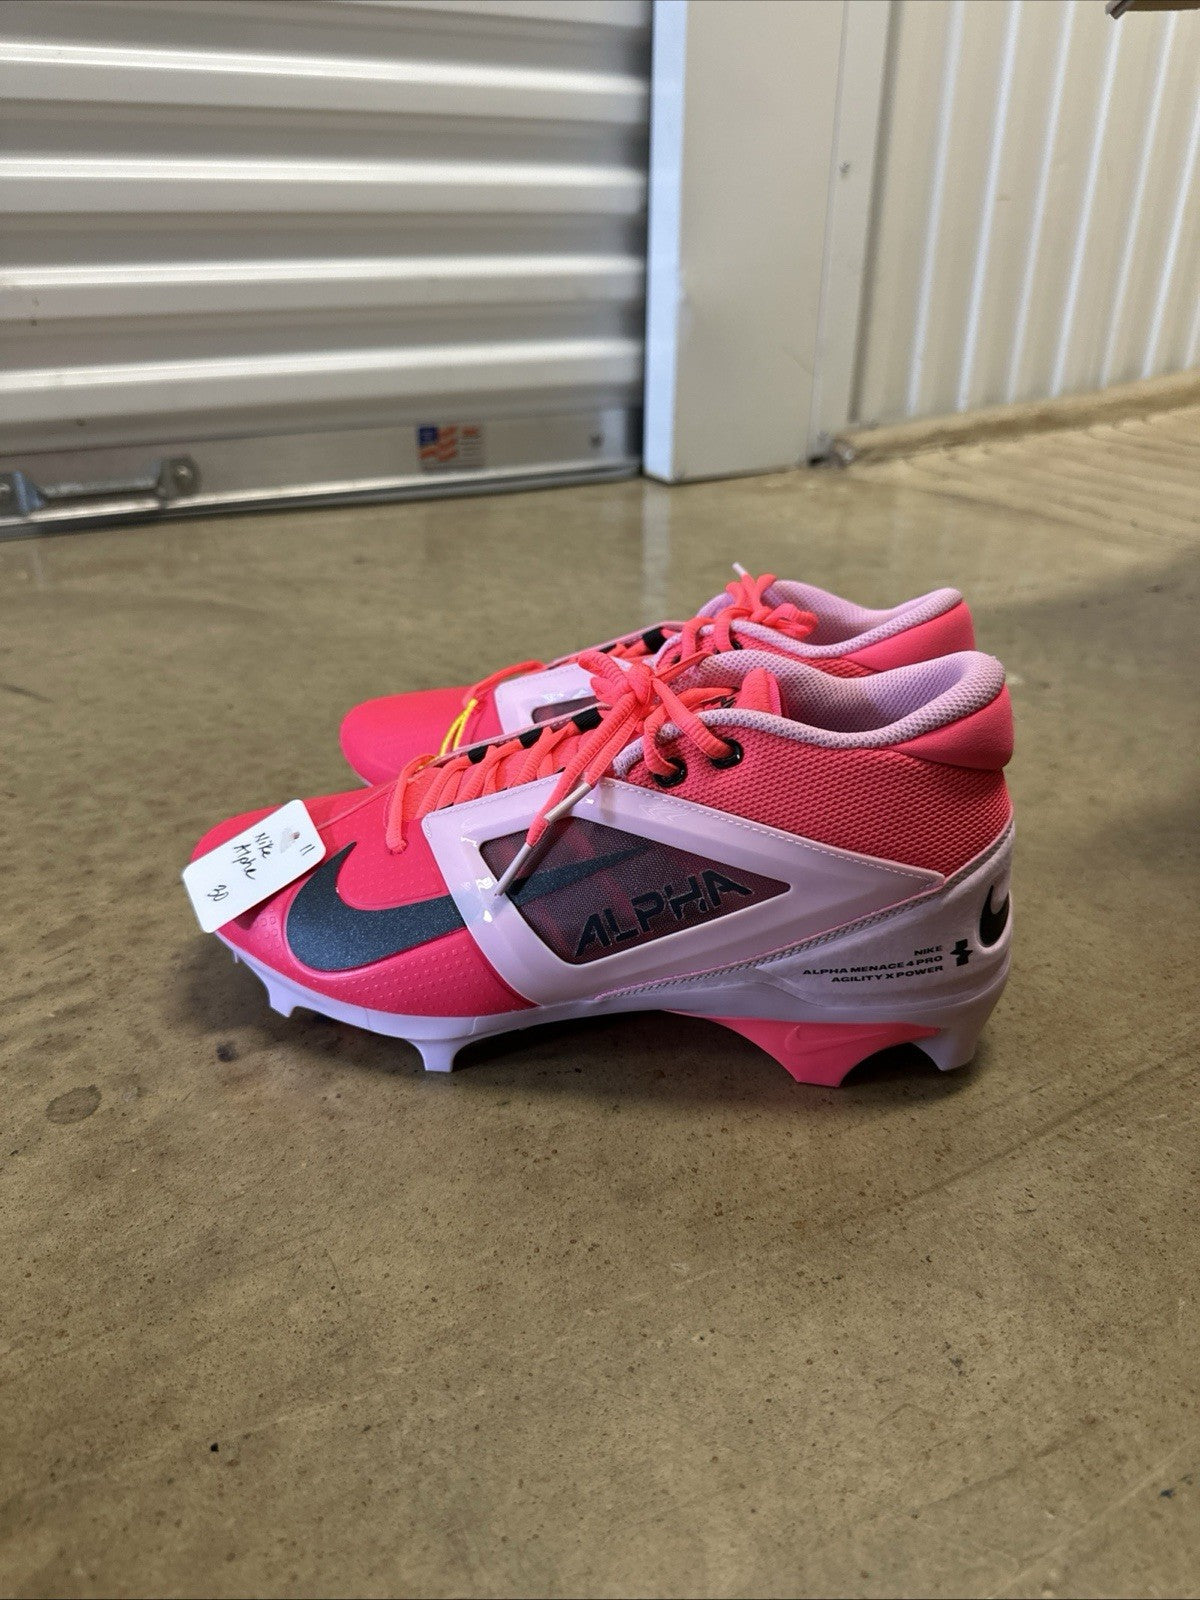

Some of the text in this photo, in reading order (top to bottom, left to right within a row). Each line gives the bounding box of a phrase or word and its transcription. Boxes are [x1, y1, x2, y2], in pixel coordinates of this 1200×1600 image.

[255, 832, 273, 859] Nike
[207, 884, 229, 902] 30
[575, 868, 752, 957] ALPHA
[913, 945, 942, 955] NIKE
[850, 961, 904, 973] MENACE
[916, 954, 943, 966] PRO
[831, 974, 882, 982] AGILITY
[896, 965, 943, 978] POWER
